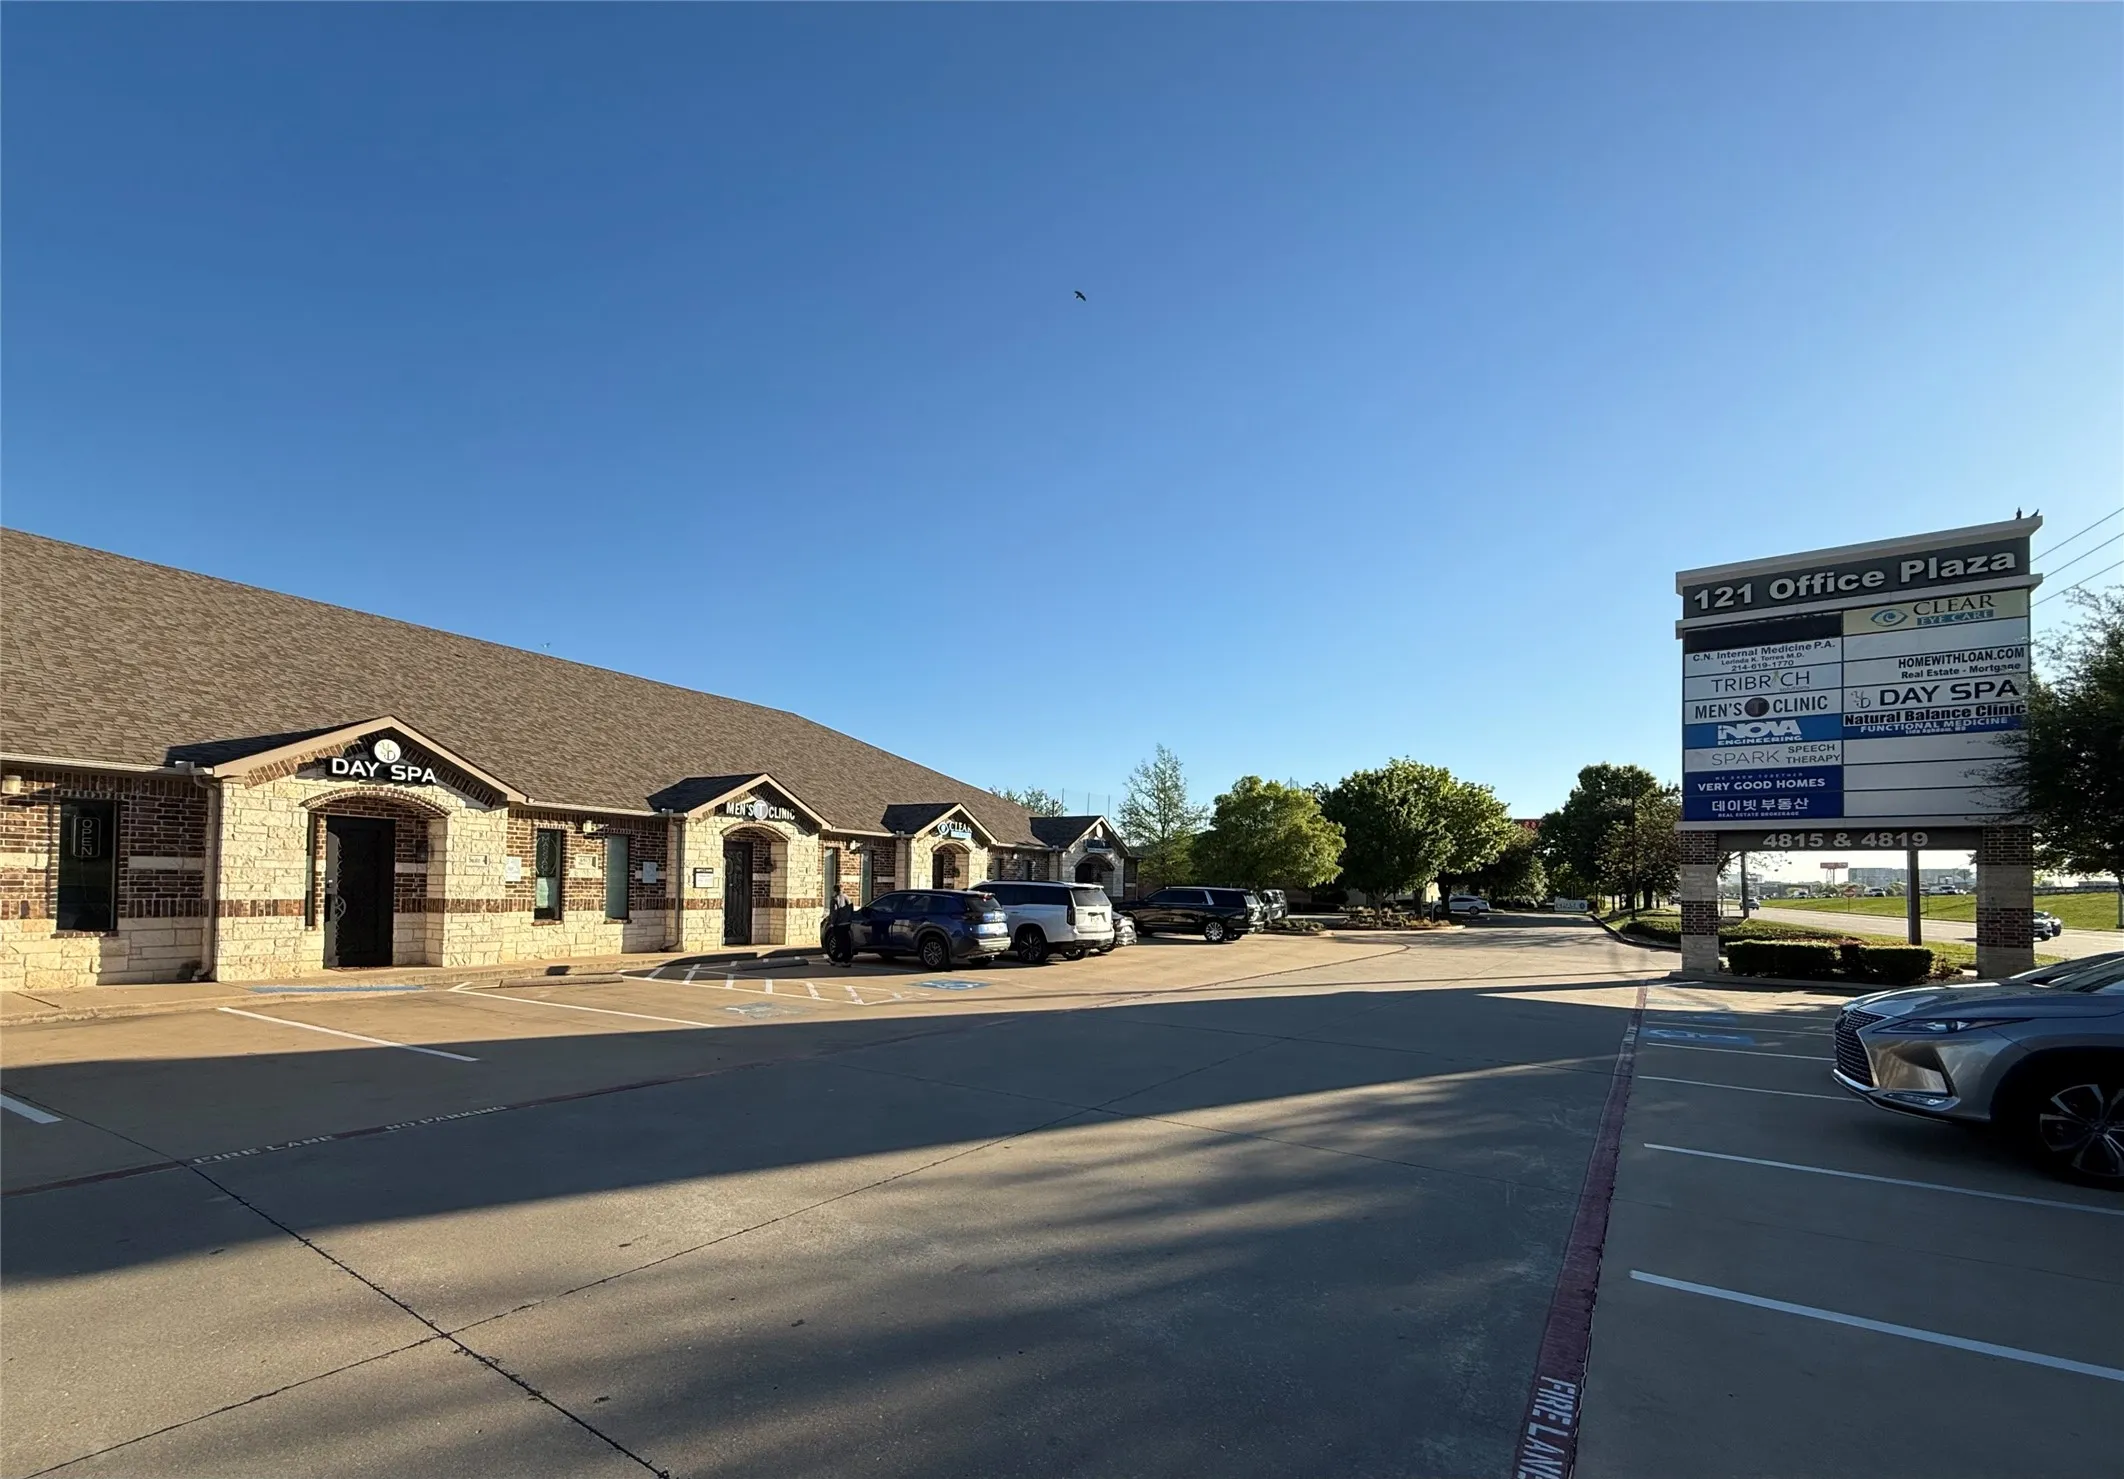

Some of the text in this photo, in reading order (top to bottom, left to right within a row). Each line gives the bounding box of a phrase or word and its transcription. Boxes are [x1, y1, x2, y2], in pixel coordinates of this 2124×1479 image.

[1694, 551, 2017, 610] 121 Office Plaza
[1913, 595, 1997, 616] CLEAR
[1920, 609, 1990, 626] EYE CARE
[1692, 640, 1837, 663] C.N. Internal Medicine P.A.
[1761, 653, 1785, 662] Torres
[1898, 647, 2026, 669] HOMEWITHLOAN.COM
[1731, 660, 1795, 672] 214-619-1770
[1901, 667, 1924, 679] Real
[1926, 667, 1960, 677] Estate
[1969, 662, 2022, 675] Mortgage
[1879, 679, 2020, 706] DAY SPA
[1694, 702, 1743, 720] MEN'S
[1773, 695, 1829, 714] CLINIC
[1844, 703, 2027, 726] Natural Balance Clinic
[1717, 719, 1803, 740] NOVA
[1860, 717, 2008, 733] FUNCTIONAL MEDICINE
[1717, 735, 1803, 745] ENGINEERING
[1711, 744, 1836, 766] SPARK SPEECH
[1785, 754, 1841, 765] THERAPY
[332, 758, 438, 784] DAY SPA
[1697, 778, 1826, 792] VERY GOOD HOMES
[726, 802, 754, 817] MEN'S
[768, 806, 796, 821] CLINIC
[1711, 797, 1810, 812] 데이빗 부동산
[81, 819, 93, 856] OPEN
[1762, 831, 1929, 848] 4815 & 4819
[194, 1105, 508, 1165] FIRE LANE NO PARKING
[1532, 1375, 1577, 1425] FIRE
